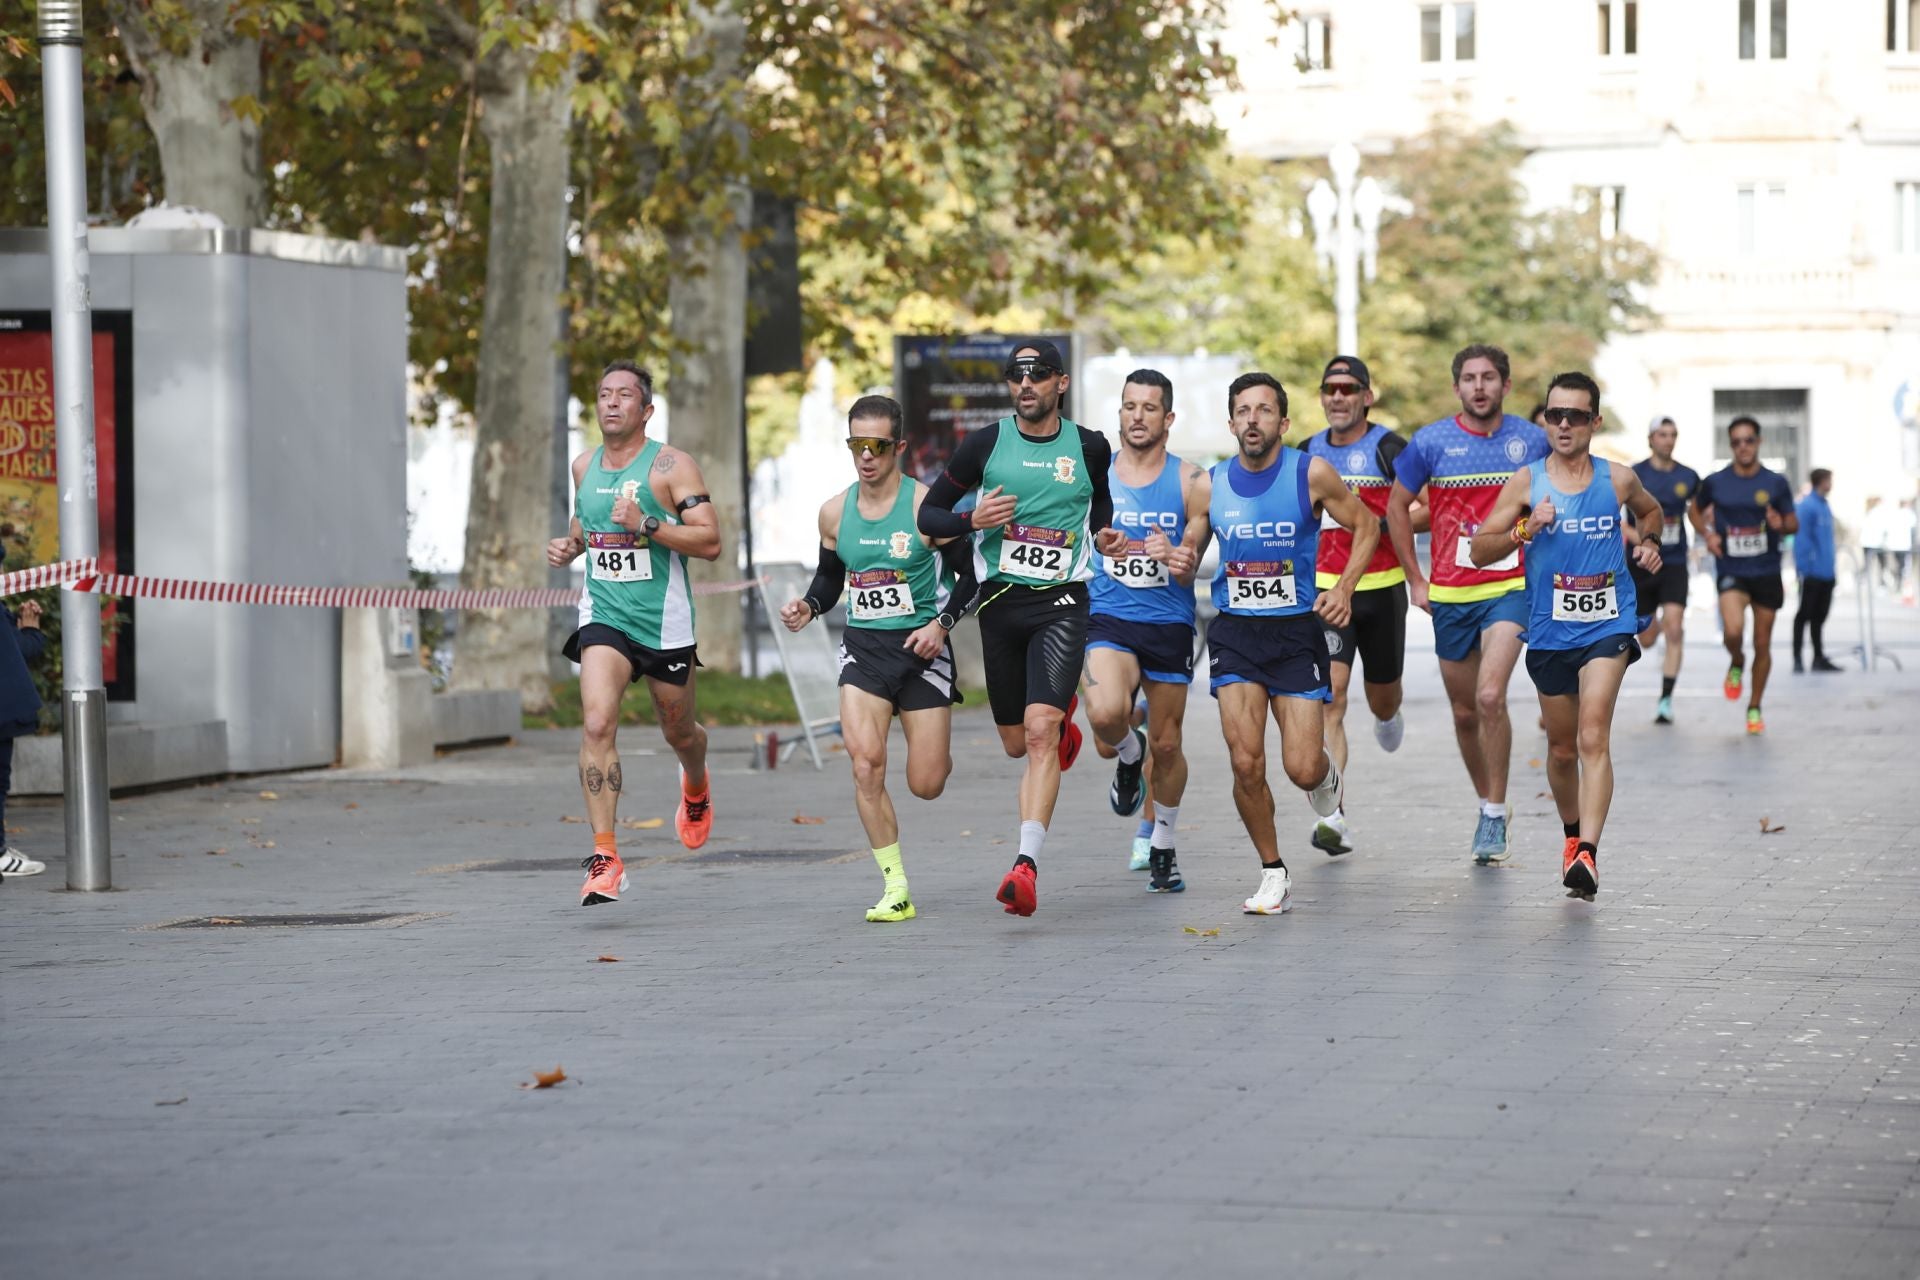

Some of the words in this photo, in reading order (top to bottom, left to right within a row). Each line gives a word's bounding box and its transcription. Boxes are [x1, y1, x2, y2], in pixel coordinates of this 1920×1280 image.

[1538, 515, 1614, 535] VECO
[1263, 539, 1295, 547] running
[597, 551, 637, 571] 481
[1010, 544, 1061, 571] 482
[1113, 558, 1159, 577] 563
[856, 587, 901, 610] 483
[1238, 578, 1285, 599] 564
[1562, 591, 1607, 613] 565
